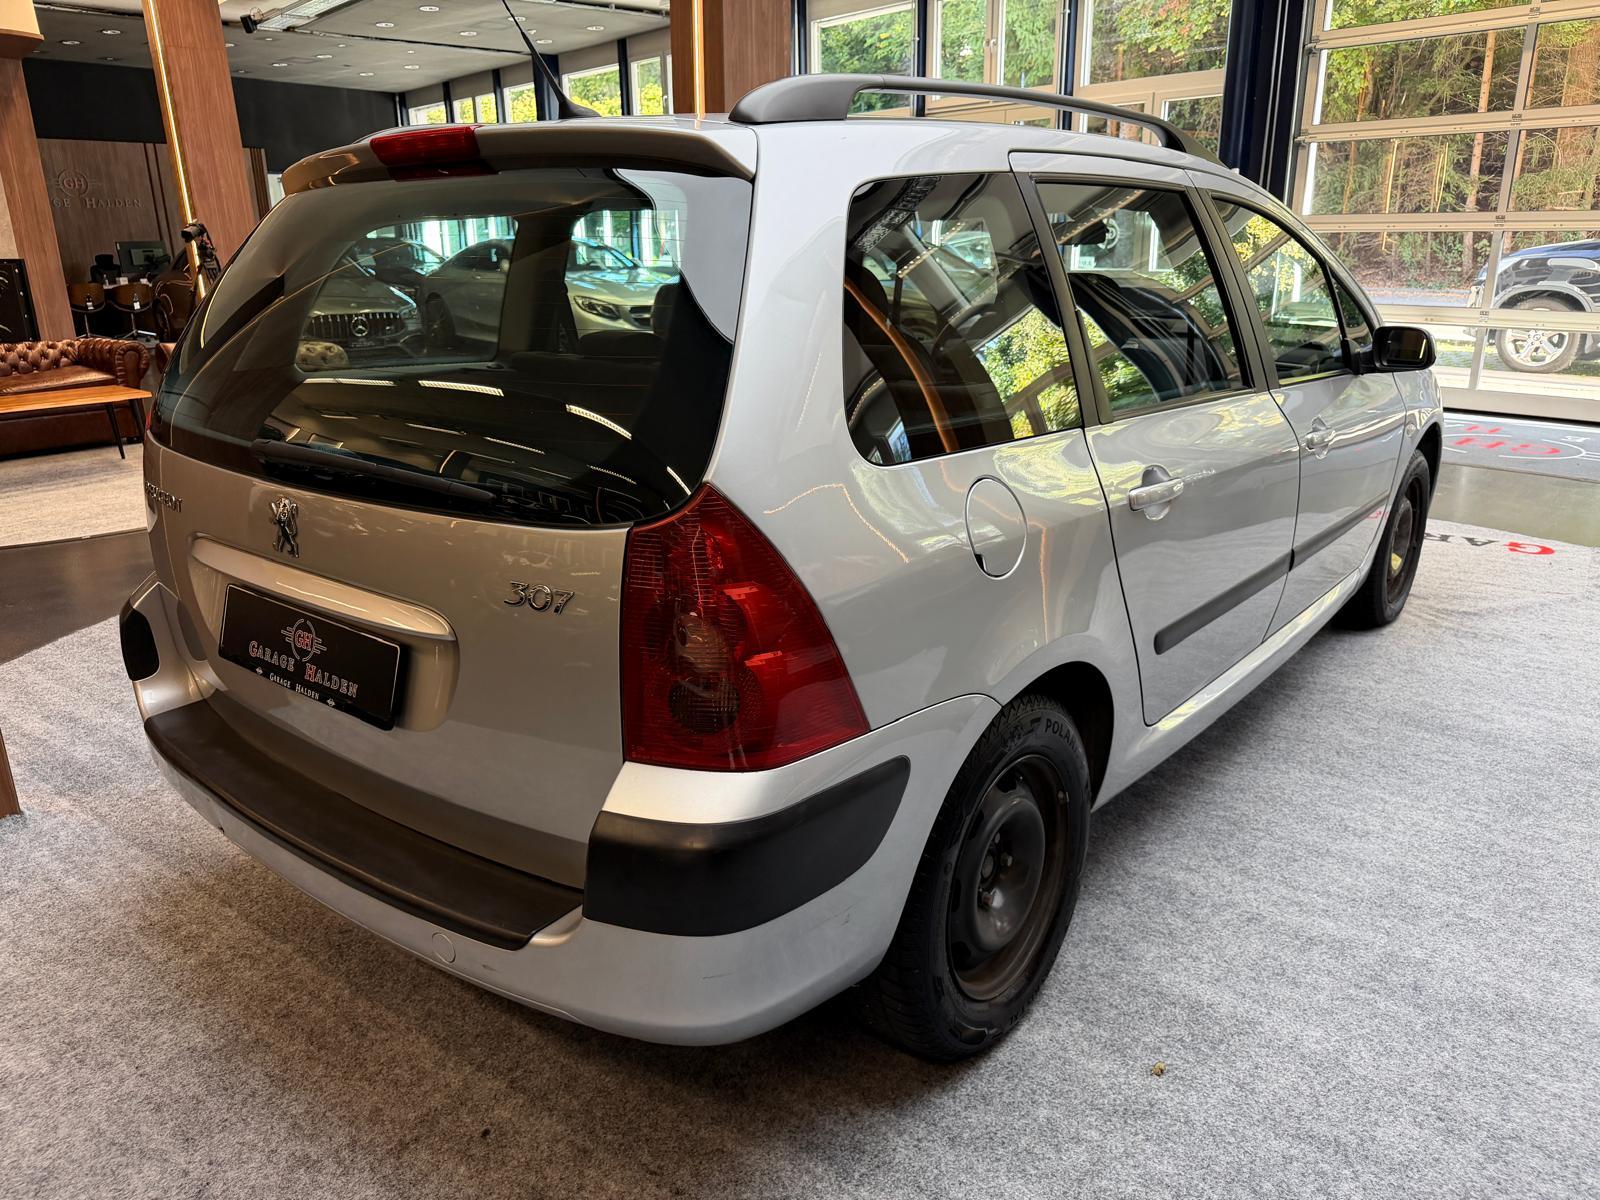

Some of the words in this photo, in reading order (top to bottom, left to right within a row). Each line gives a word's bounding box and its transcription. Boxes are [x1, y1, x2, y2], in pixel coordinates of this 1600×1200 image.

[63, 178, 86, 189] GH
[85, 197, 142, 209] HALDEN
[504, 581, 575, 615] 307
[294, 630, 313, 651] GH
[249, 640, 295, 672] GARAGE
[304, 662, 358, 698] HALDEN
[269, 672, 291, 688] GARAGE
[295, 683, 320, 700] HALDEN
